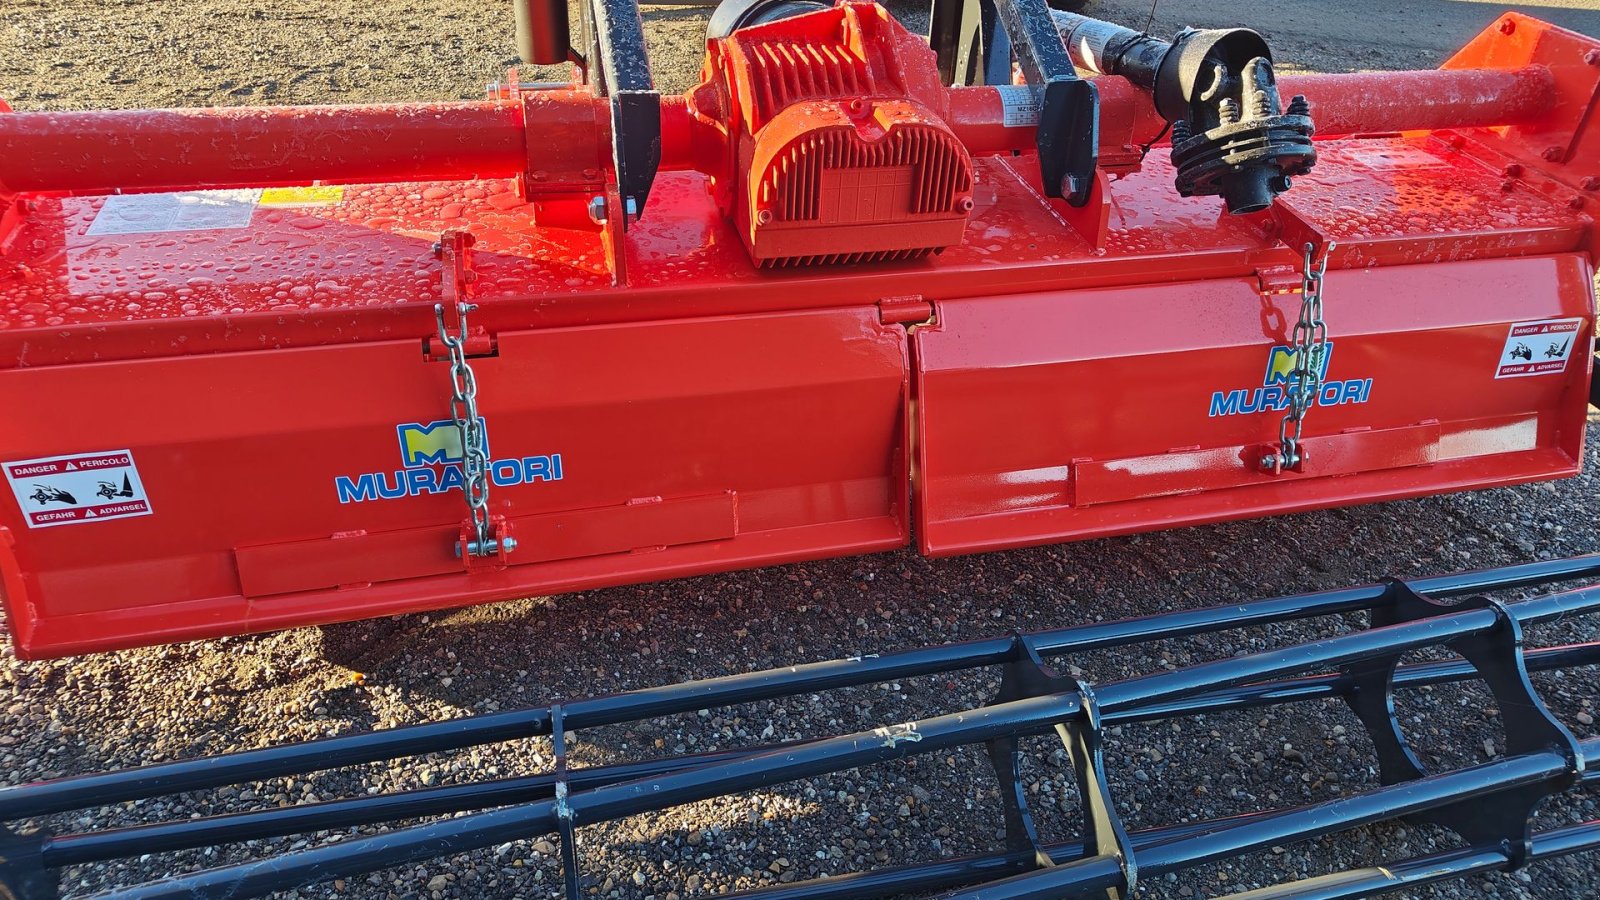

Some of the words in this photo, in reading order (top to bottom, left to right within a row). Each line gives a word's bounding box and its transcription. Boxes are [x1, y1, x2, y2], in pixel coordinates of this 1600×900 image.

[1513, 326, 1538, 335] DANGER
[1549, 323, 1578, 331] PERICOLO
[1502, 366, 1524, 374] GEFAHR
[1536, 362, 1564, 371] ADVARSEL
[14, 464, 58, 476] DANGER
[79, 456, 129, 468] PERICOLO
[36, 511, 76, 522] GEFAHR
[99, 503, 147, 515] ADVARSEL
